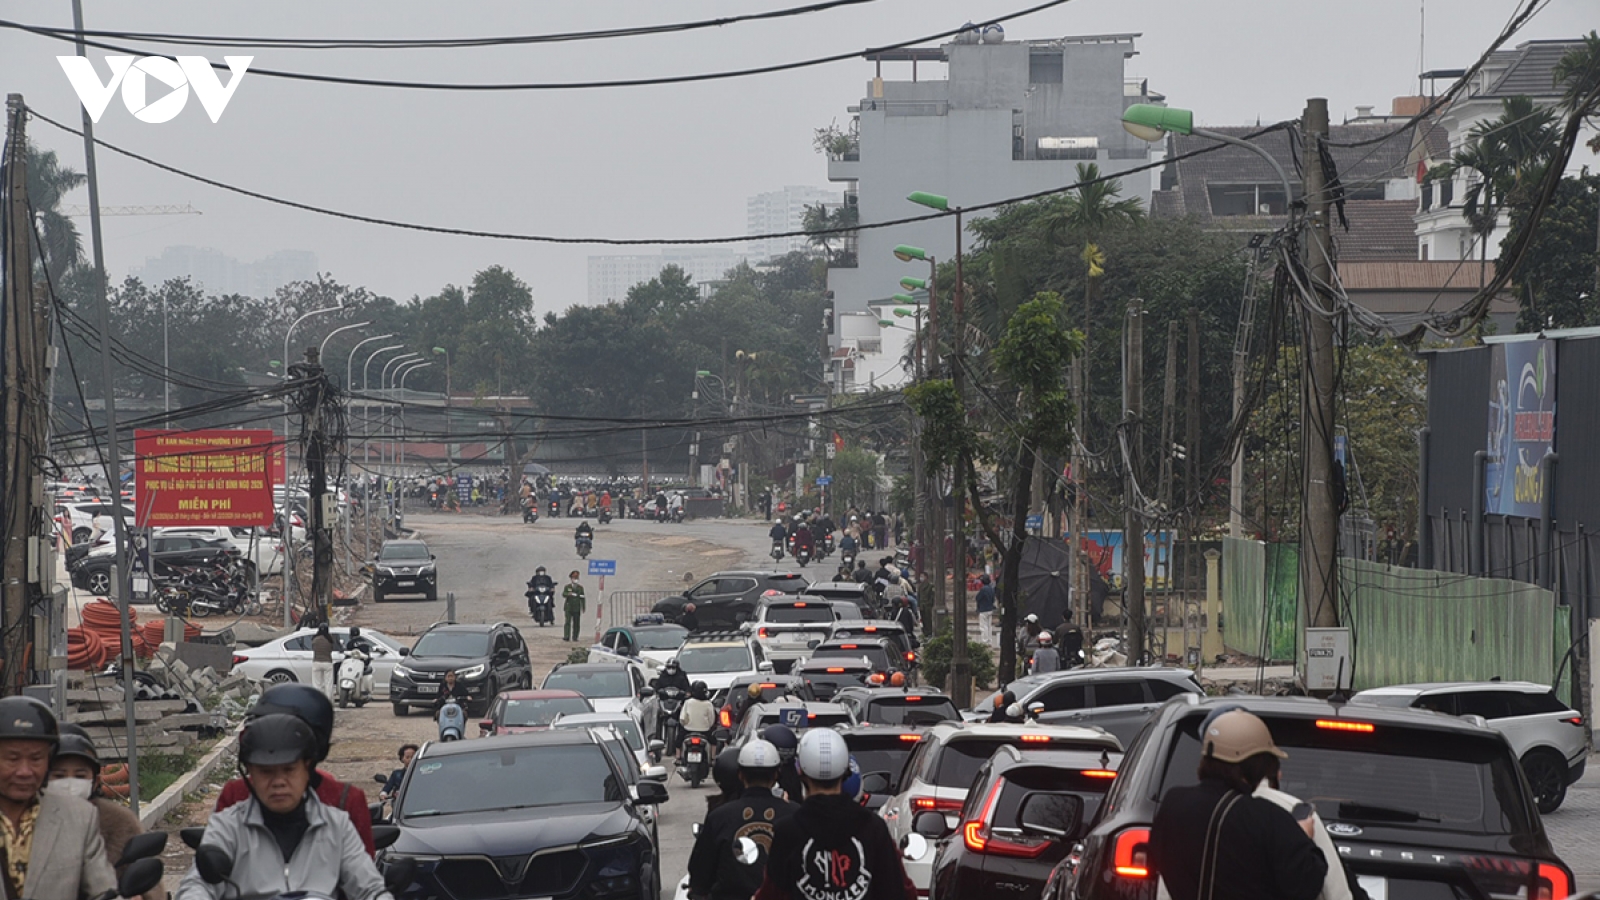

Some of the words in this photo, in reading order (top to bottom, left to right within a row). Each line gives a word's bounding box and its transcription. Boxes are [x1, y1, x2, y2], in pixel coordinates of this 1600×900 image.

[178, 496, 209, 510] MIỄN
[211, 497, 231, 510] PHÍ
[1338, 846, 1445, 863] REST
